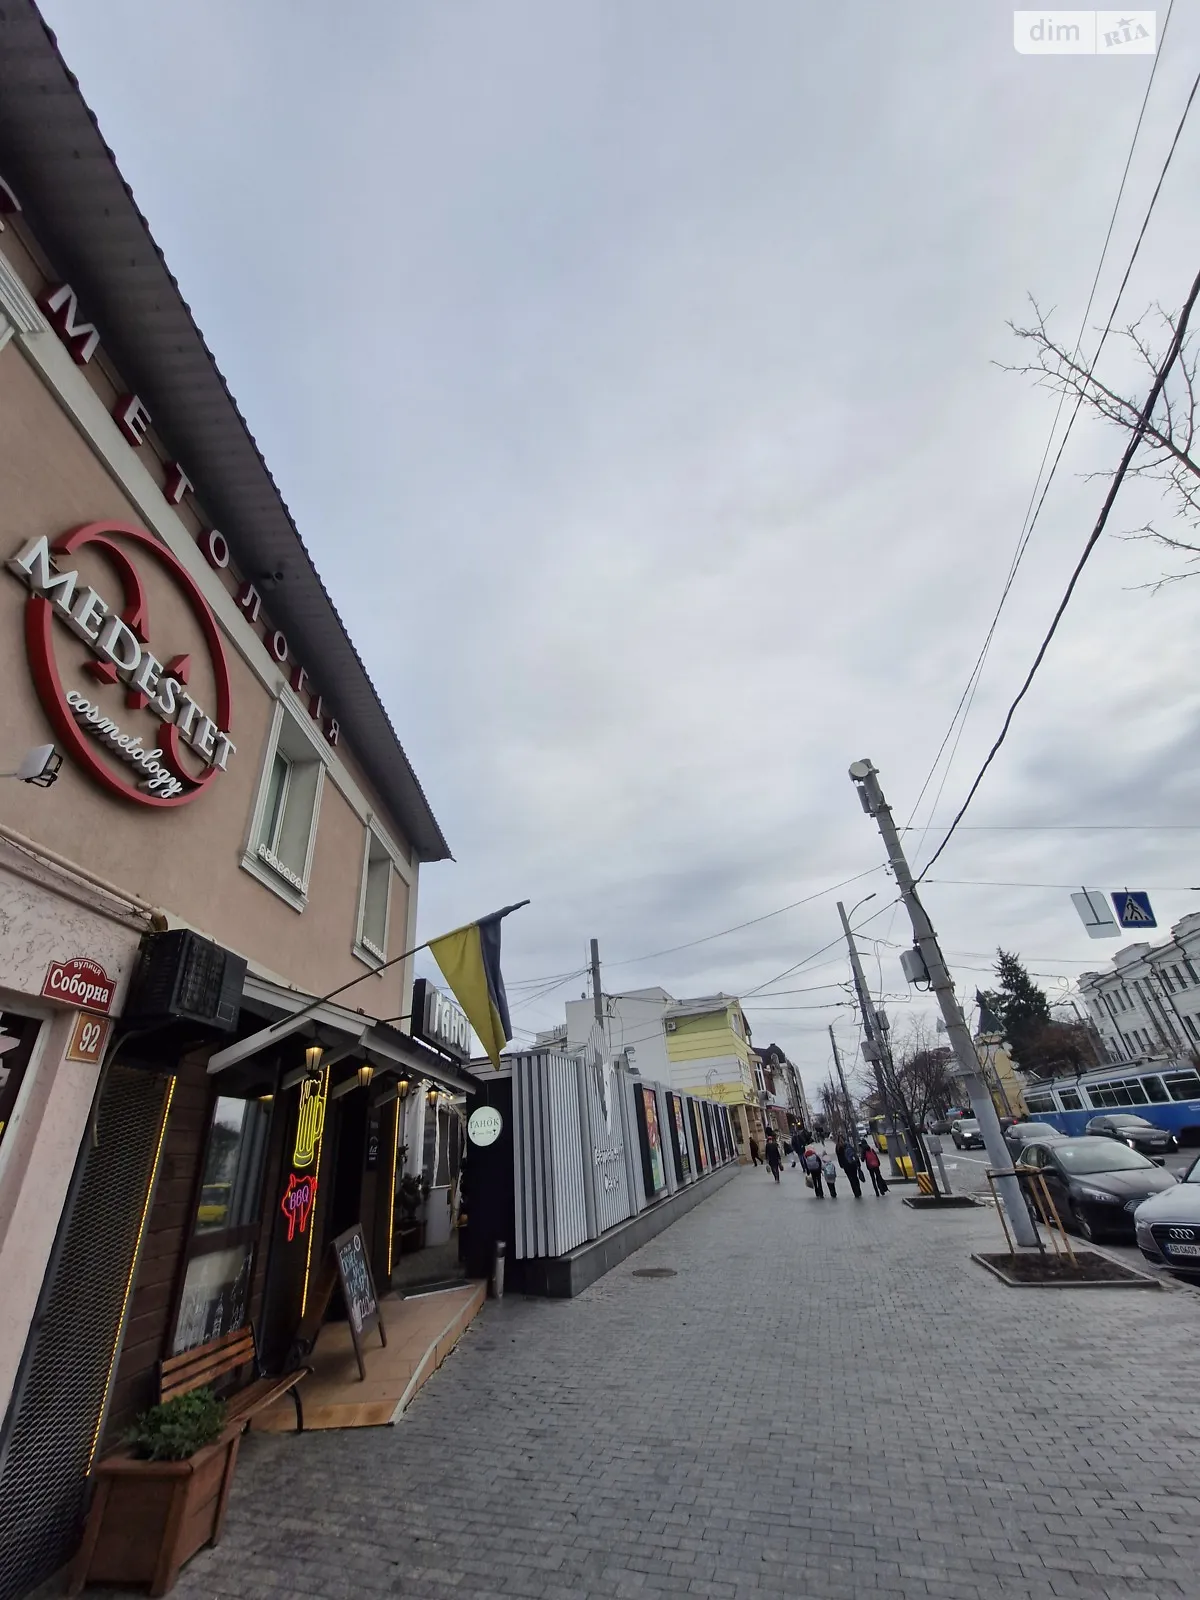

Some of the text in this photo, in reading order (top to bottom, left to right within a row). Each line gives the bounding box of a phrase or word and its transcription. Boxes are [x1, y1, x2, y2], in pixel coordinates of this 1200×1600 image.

[8, 535, 237, 772] MEDESTET
[65, 690, 183, 799] cosmetology
[73, 961, 102, 976] вулиця
[50, 968, 110, 1004] Соборна
[79, 1022, 101, 1054] 92
[290, 1185, 309, 1210] BBQ
